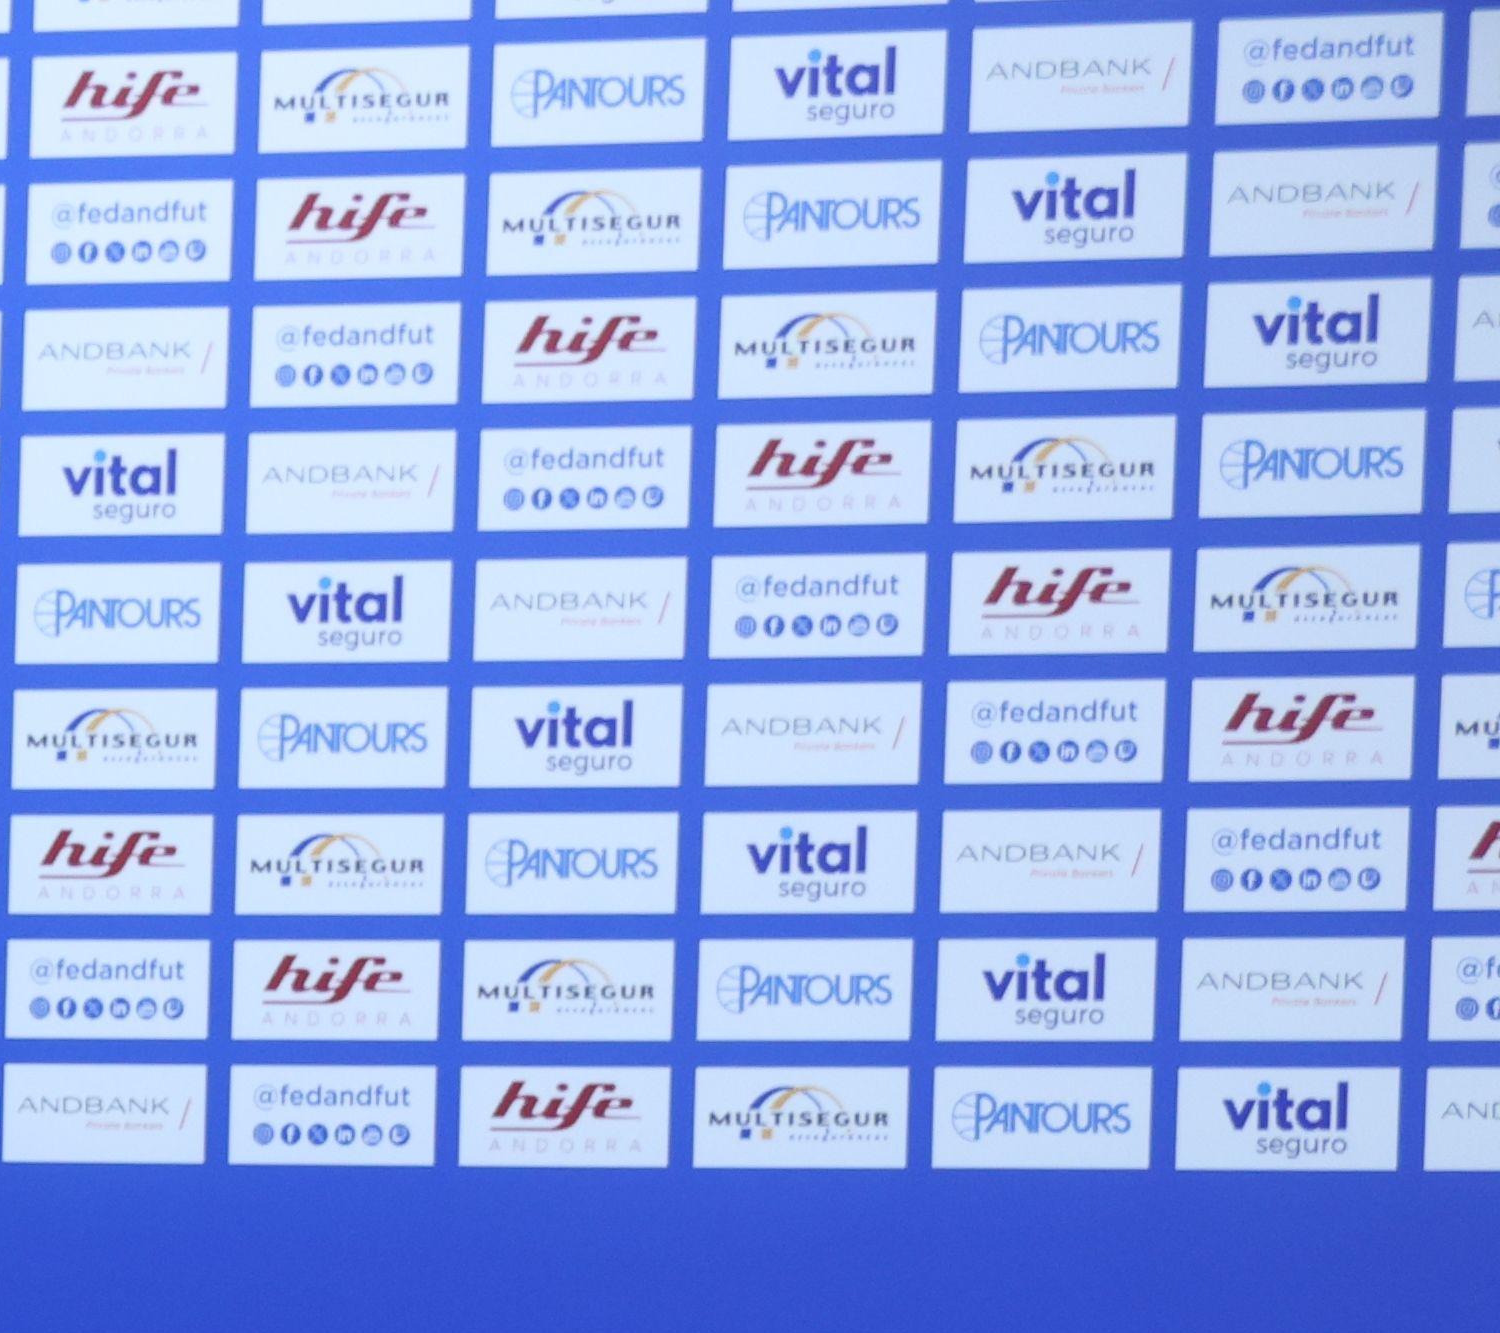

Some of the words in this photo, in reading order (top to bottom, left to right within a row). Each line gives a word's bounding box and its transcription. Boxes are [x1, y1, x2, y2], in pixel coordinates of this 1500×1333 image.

[1242, 31, 1415, 67] @fedandfut
[773, 43, 898, 99] vital
[986, 55, 1153, 82] ANDBANK
[61, 65, 209, 123] hife
[274, 91, 450, 112] MULTISEGUR
[531, 62, 687, 118] PANTOURS
[804, 100, 896, 127] seguro
[1010, 167, 1137, 223] vital
[1226, 179, 1396, 206] ANDBANK
[50, 197, 209, 228] @fedandfut
[285, 187, 435, 245] hife
[502, 213, 681, 235] MULTISEGUR
[766, 185, 924, 240] PANTOURS
[1042, 224, 1136, 250] seguro
[1252, 291, 1381, 348] vital
[36, 339, 192, 362] ANDBANK
[275, 320, 436, 352] @fedandfut
[513, 310, 666, 368] hife
[733, 336, 916, 357] MULTISEGUR
[1001, 309, 1162, 364] PANTOURS
[1284, 348, 1379, 375] seguro
[60, 446, 178, 498] vital
[261, 461, 418, 485] ANDBANK
[502, 444, 665, 475] @fedandfut
[744, 434, 901, 491] hife
[970, 461, 1156, 481] MULTISEGUR
[1241, 434, 1405, 489] PANTOURS
[90, 501, 177, 525] seguro
[285, 573, 405, 625] vital
[489, 589, 648, 613] ANDBANK
[735, 571, 900, 602] @fedandfut
[981, 563, 1141, 619] hife
[1209, 591, 1397, 609] MULTISEGUR
[54, 586, 203, 637] PANTOURS
[316, 628, 404, 652] seguro
[513, 697, 635, 750] vital
[720, 713, 883, 737] ANDBANK
[971, 697, 1139, 727] @fedandfut
[1221, 689, 1383, 745] hife
[26, 733, 197, 750] MULTISEGUR
[278, 710, 429, 762] PANTOURS
[544, 752, 634, 777] seguro
[39, 827, 185, 879] hife
[746, 824, 870, 875] vital
[956, 841, 1122, 864] ANDBANK
[1211, 825, 1382, 855] @fedandfut
[249, 858, 425, 874] MULTISEGUR
[505, 837, 659, 887] PANTOURS
[777, 878, 868, 903] seguro
[29, 957, 185, 984] @fedandfut
[262, 953, 412, 1004] hife
[981, 951, 1106, 1003] vital
[1195, 969, 1364, 992] ANDBANK
[477, 985, 654, 1001] MULTISEGUR
[738, 963, 895, 1014] PANTOURS
[1013, 1006, 1105, 1030] seguro
[16, 1095, 171, 1115] ANDBANK
[253, 1083, 411, 1110] @fedandfut
[490, 1080, 642, 1132] hife
[1221, 1080, 1349, 1131] vital
[708, 1112, 889, 1128] MULTISEGUR
[974, 1091, 1133, 1141] PANTOURS
[1253, 1135, 1348, 1159] seguro
